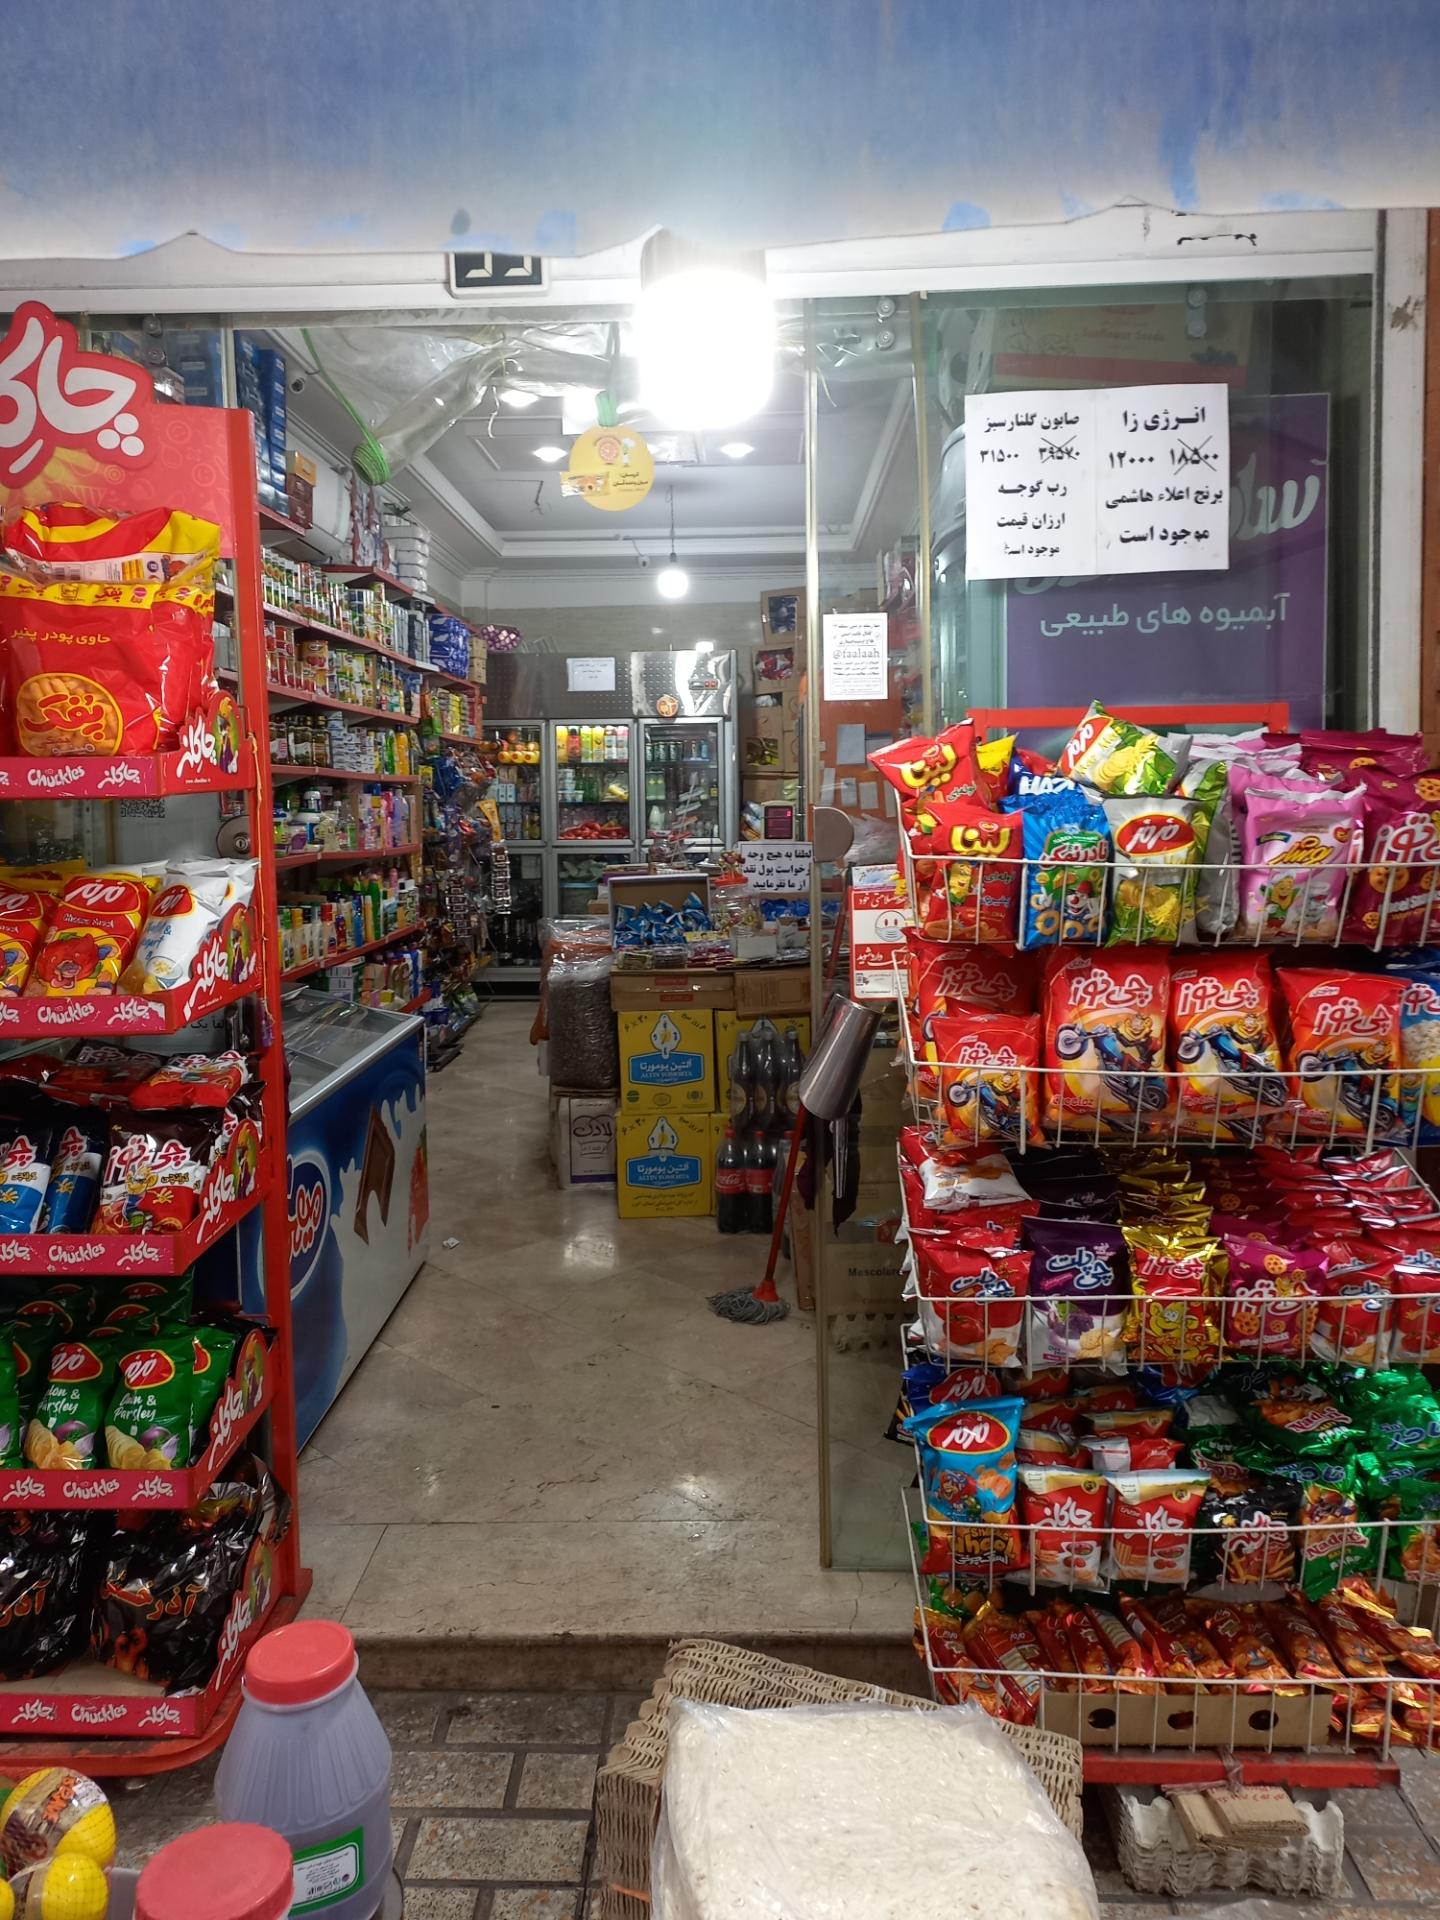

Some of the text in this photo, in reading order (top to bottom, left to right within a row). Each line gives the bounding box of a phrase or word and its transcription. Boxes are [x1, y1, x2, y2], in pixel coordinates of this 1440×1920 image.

[984, 412, 1080, 433] صابون گلنار سبز
[1122, 407, 1206, 432] انرژی زا
[980, 448, 1019, 463] ۳۱۵۰۰
[1109, 451, 1155, 469] ۱۲۰۰۰
[998, 479, 1067, 497] رب گوجه
[1105, 486, 1223, 509] برنج اعلاء هاشمی
[997, 513, 1065, 529] ارزان قیمت
[1119, 526, 1210, 546] موجود است
[1028, 544, 1060, 558] موجود
[1040, 592, 1291, 637] آبمیوه های طبیعی
[10, 627, 112, 647] حاوی پودر پنیر
[176, 714, 217, 778] چاکلز
[27, 765, 86, 789] Chuckles
[97, 761, 142, 789] چاکلز
[1126, 817, 1180, 852] مزمز
[747, 849, 812, 861] لطفا به هیچ وجه
[743, 864, 756, 873] نقد
[758, 864, 774, 877] پول
[64, 880, 126, 906] مزمز
[788, 879, 796, 888] ما
[797, 879, 806, 891] از
[183, 935, 229, 1022] چاکلز
[37, 1002, 96, 1026] Chuckles
[107, 998, 150, 1026] چاکلز
[49, 1243, 106, 1265] Chuckles
[116, 1240, 161, 1267] چاکلز
[71, 1388, 81, 1400] &
[147, 1394, 157, 1406] &
[113, 1406, 157, 1422] Parsley
[942, 1414, 991, 1449] مزمز
[2, 1475, 47, 1501] چاکلز
[62, 1477, 121, 1500] Chuckles
[131, 1474, 175, 1502] چاکلز
[11, 1699, 55, 1724] چاکلز
[71, 1703, 128, 1724] Chuckles
[138, 1702, 181, 1728] چاکلز
